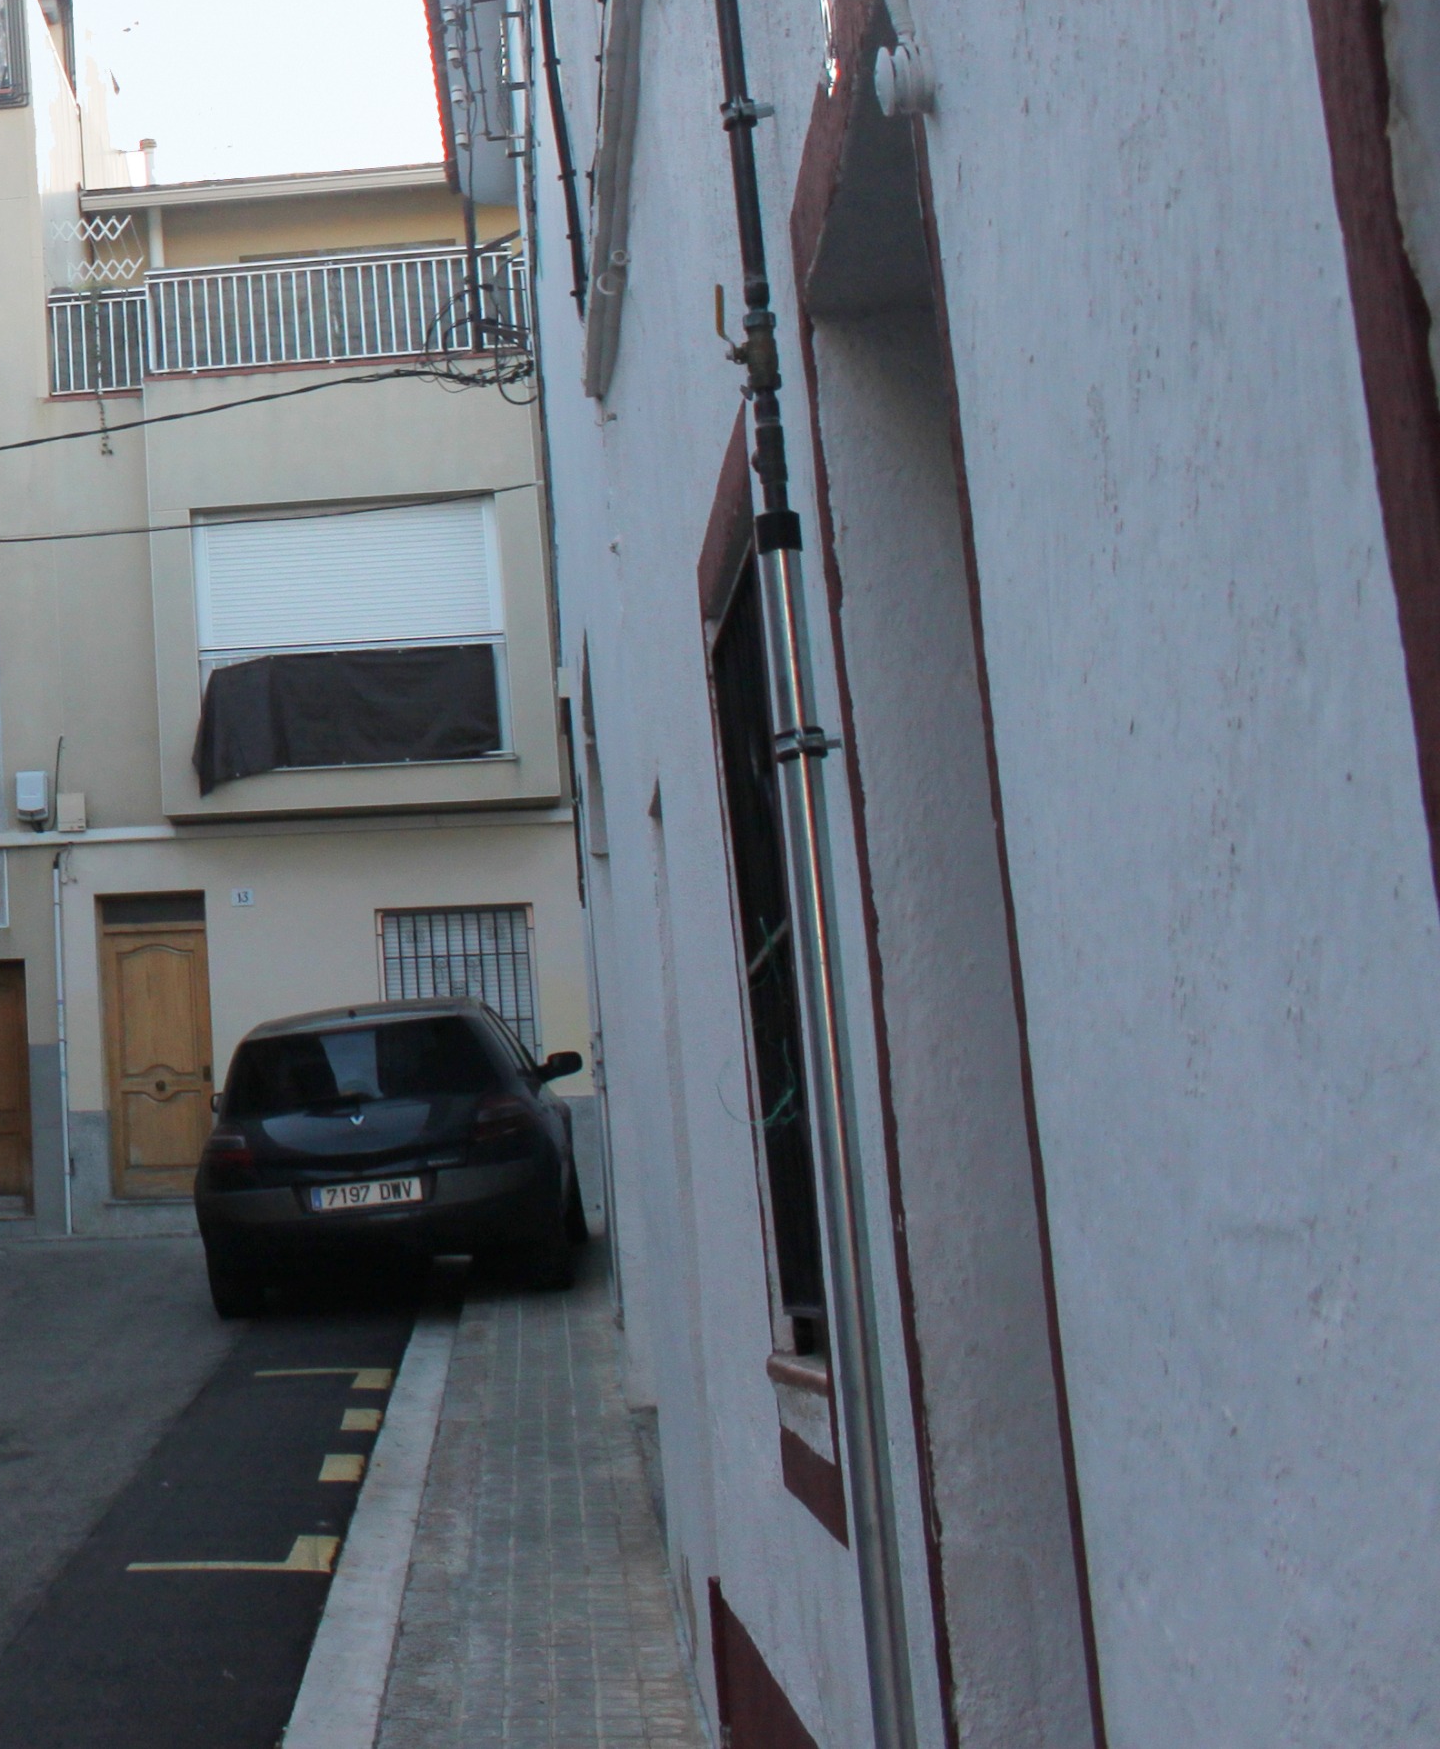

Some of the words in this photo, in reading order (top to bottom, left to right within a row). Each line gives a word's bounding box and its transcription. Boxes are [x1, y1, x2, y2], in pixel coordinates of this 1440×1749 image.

[237, 891, 249, 904] 13
[326, 1184, 370, 1206] 7197
[378, 1180, 412, 1200] DWV
